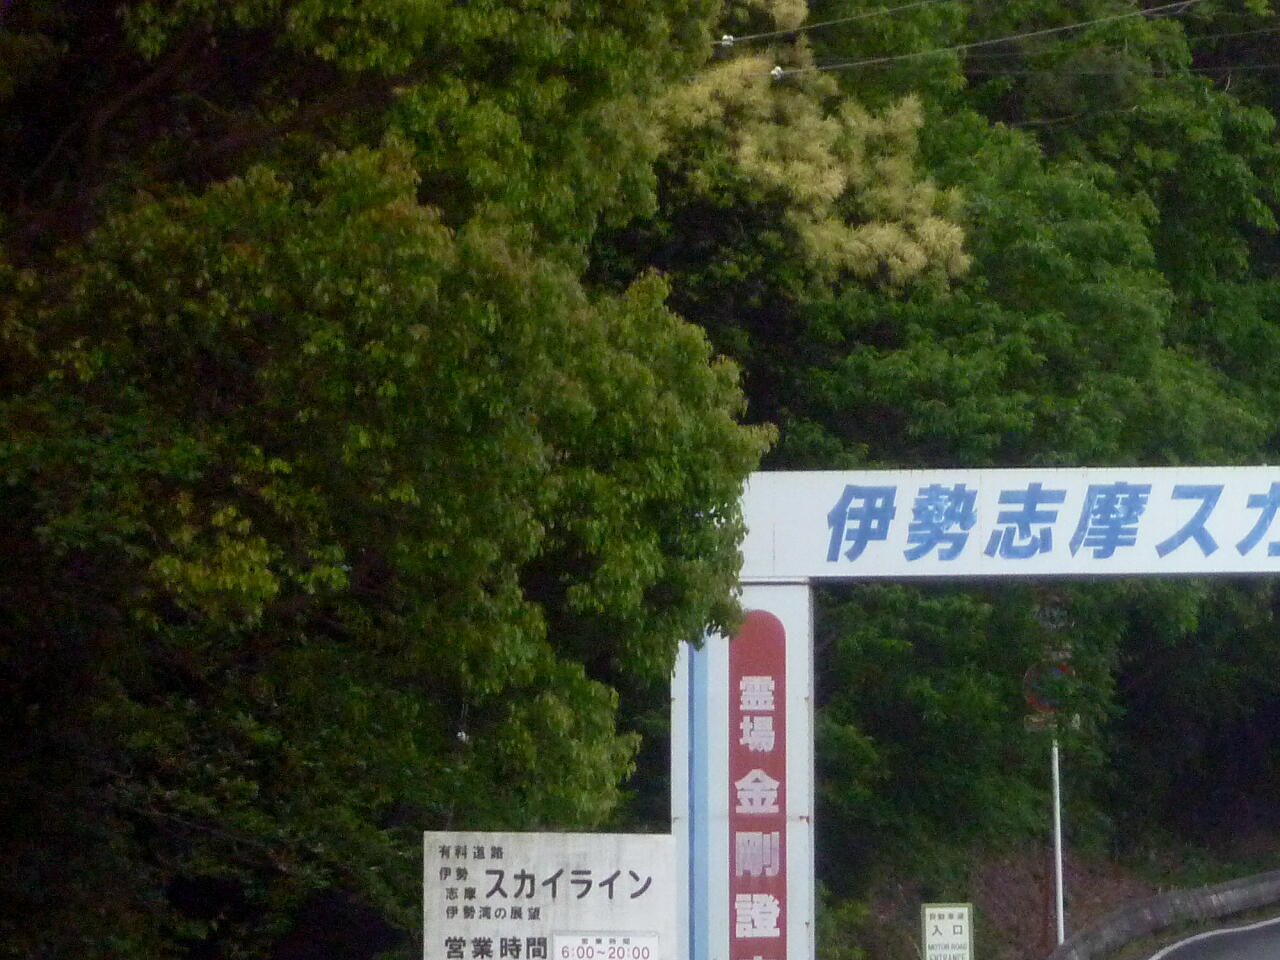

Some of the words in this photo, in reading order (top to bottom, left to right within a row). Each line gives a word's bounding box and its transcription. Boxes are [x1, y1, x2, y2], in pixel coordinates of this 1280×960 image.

[438, 845, 504, 860] 有料道路
[438, 866, 469, 881] 伊勢
[485, 868, 653, 900] スカイライン
[445, 906, 542, 921] 伊勢湾の展望
[445, 935, 549, 960] 営業時間
